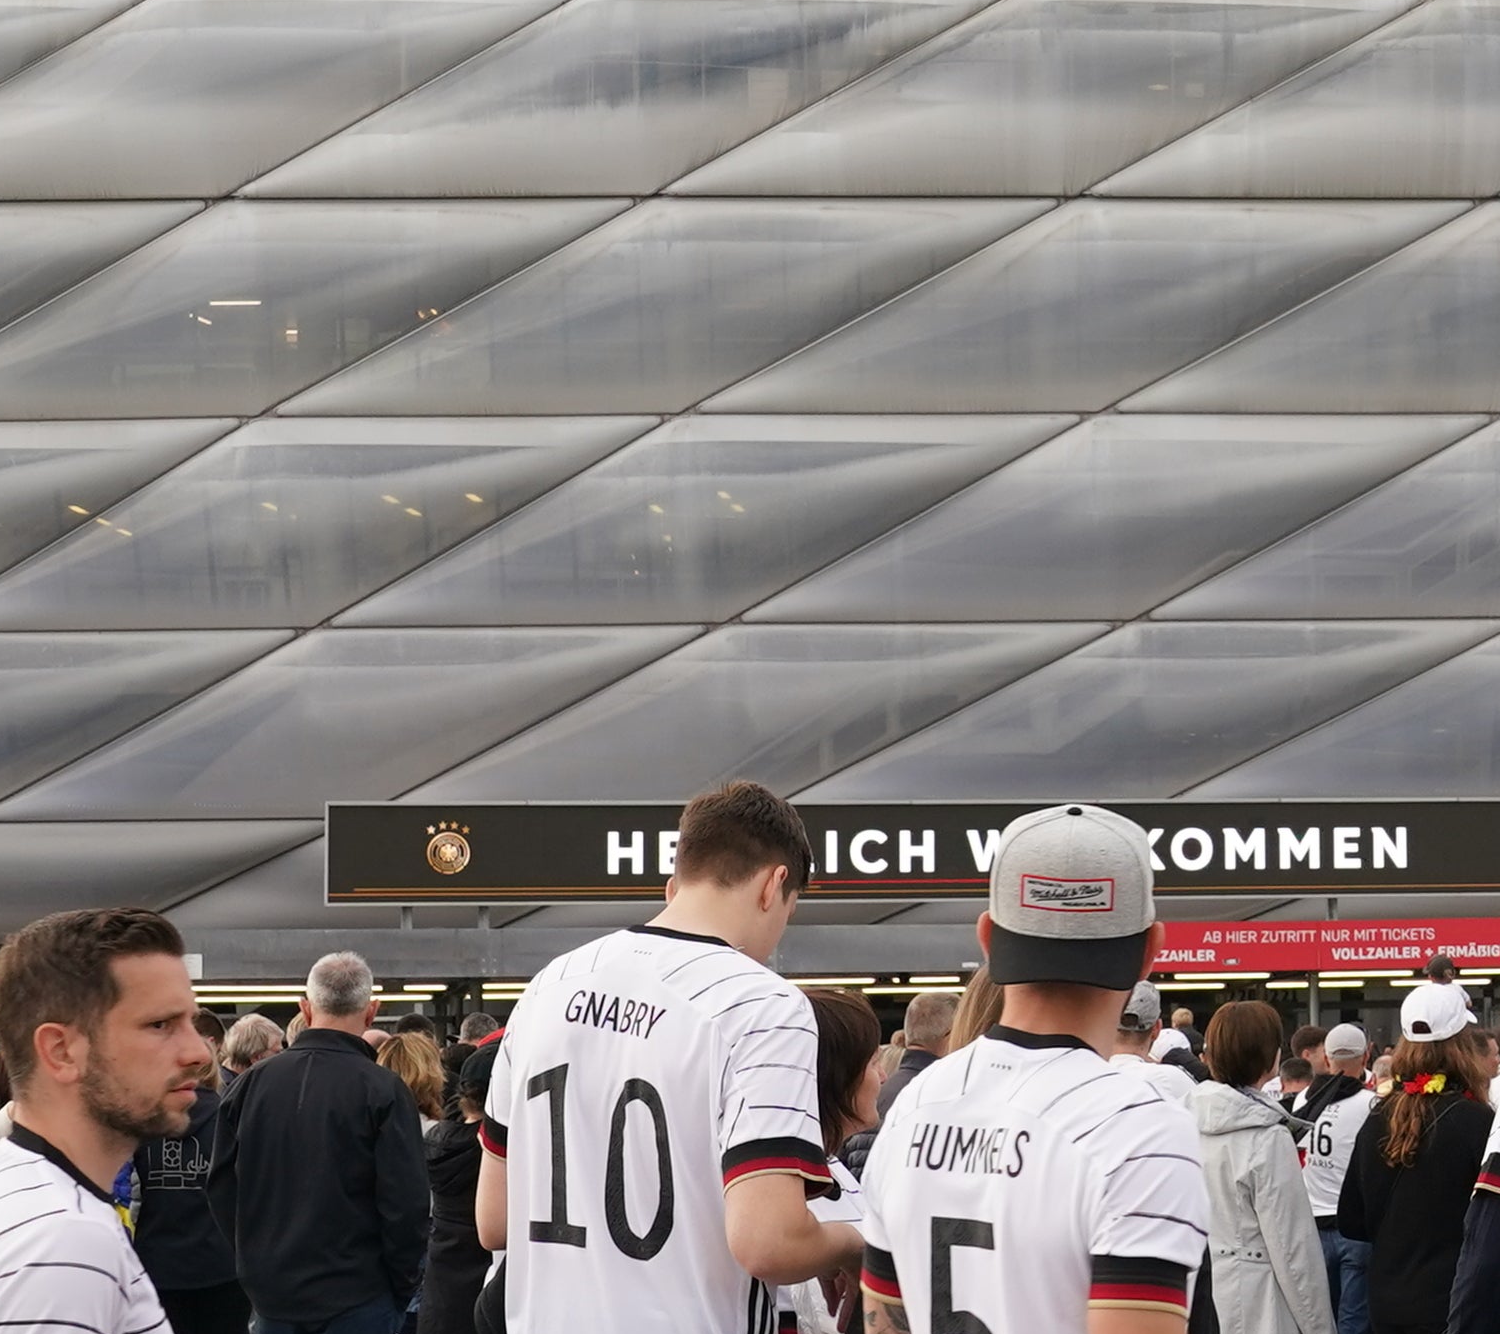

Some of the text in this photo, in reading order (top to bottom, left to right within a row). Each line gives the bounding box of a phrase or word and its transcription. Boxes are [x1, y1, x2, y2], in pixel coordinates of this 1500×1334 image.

[607, 829, 936, 875] HEICH
[1202, 927, 1436, 944] AB HIER ZUTRITT NUR MIT TICKETS
[1331, 946, 1420, 960] VOLLZAHLER
[565, 989, 667, 1040] GNABRY
[527, 1062, 675, 1262] 10
[905, 1123, 1030, 1178] HUMMELS
